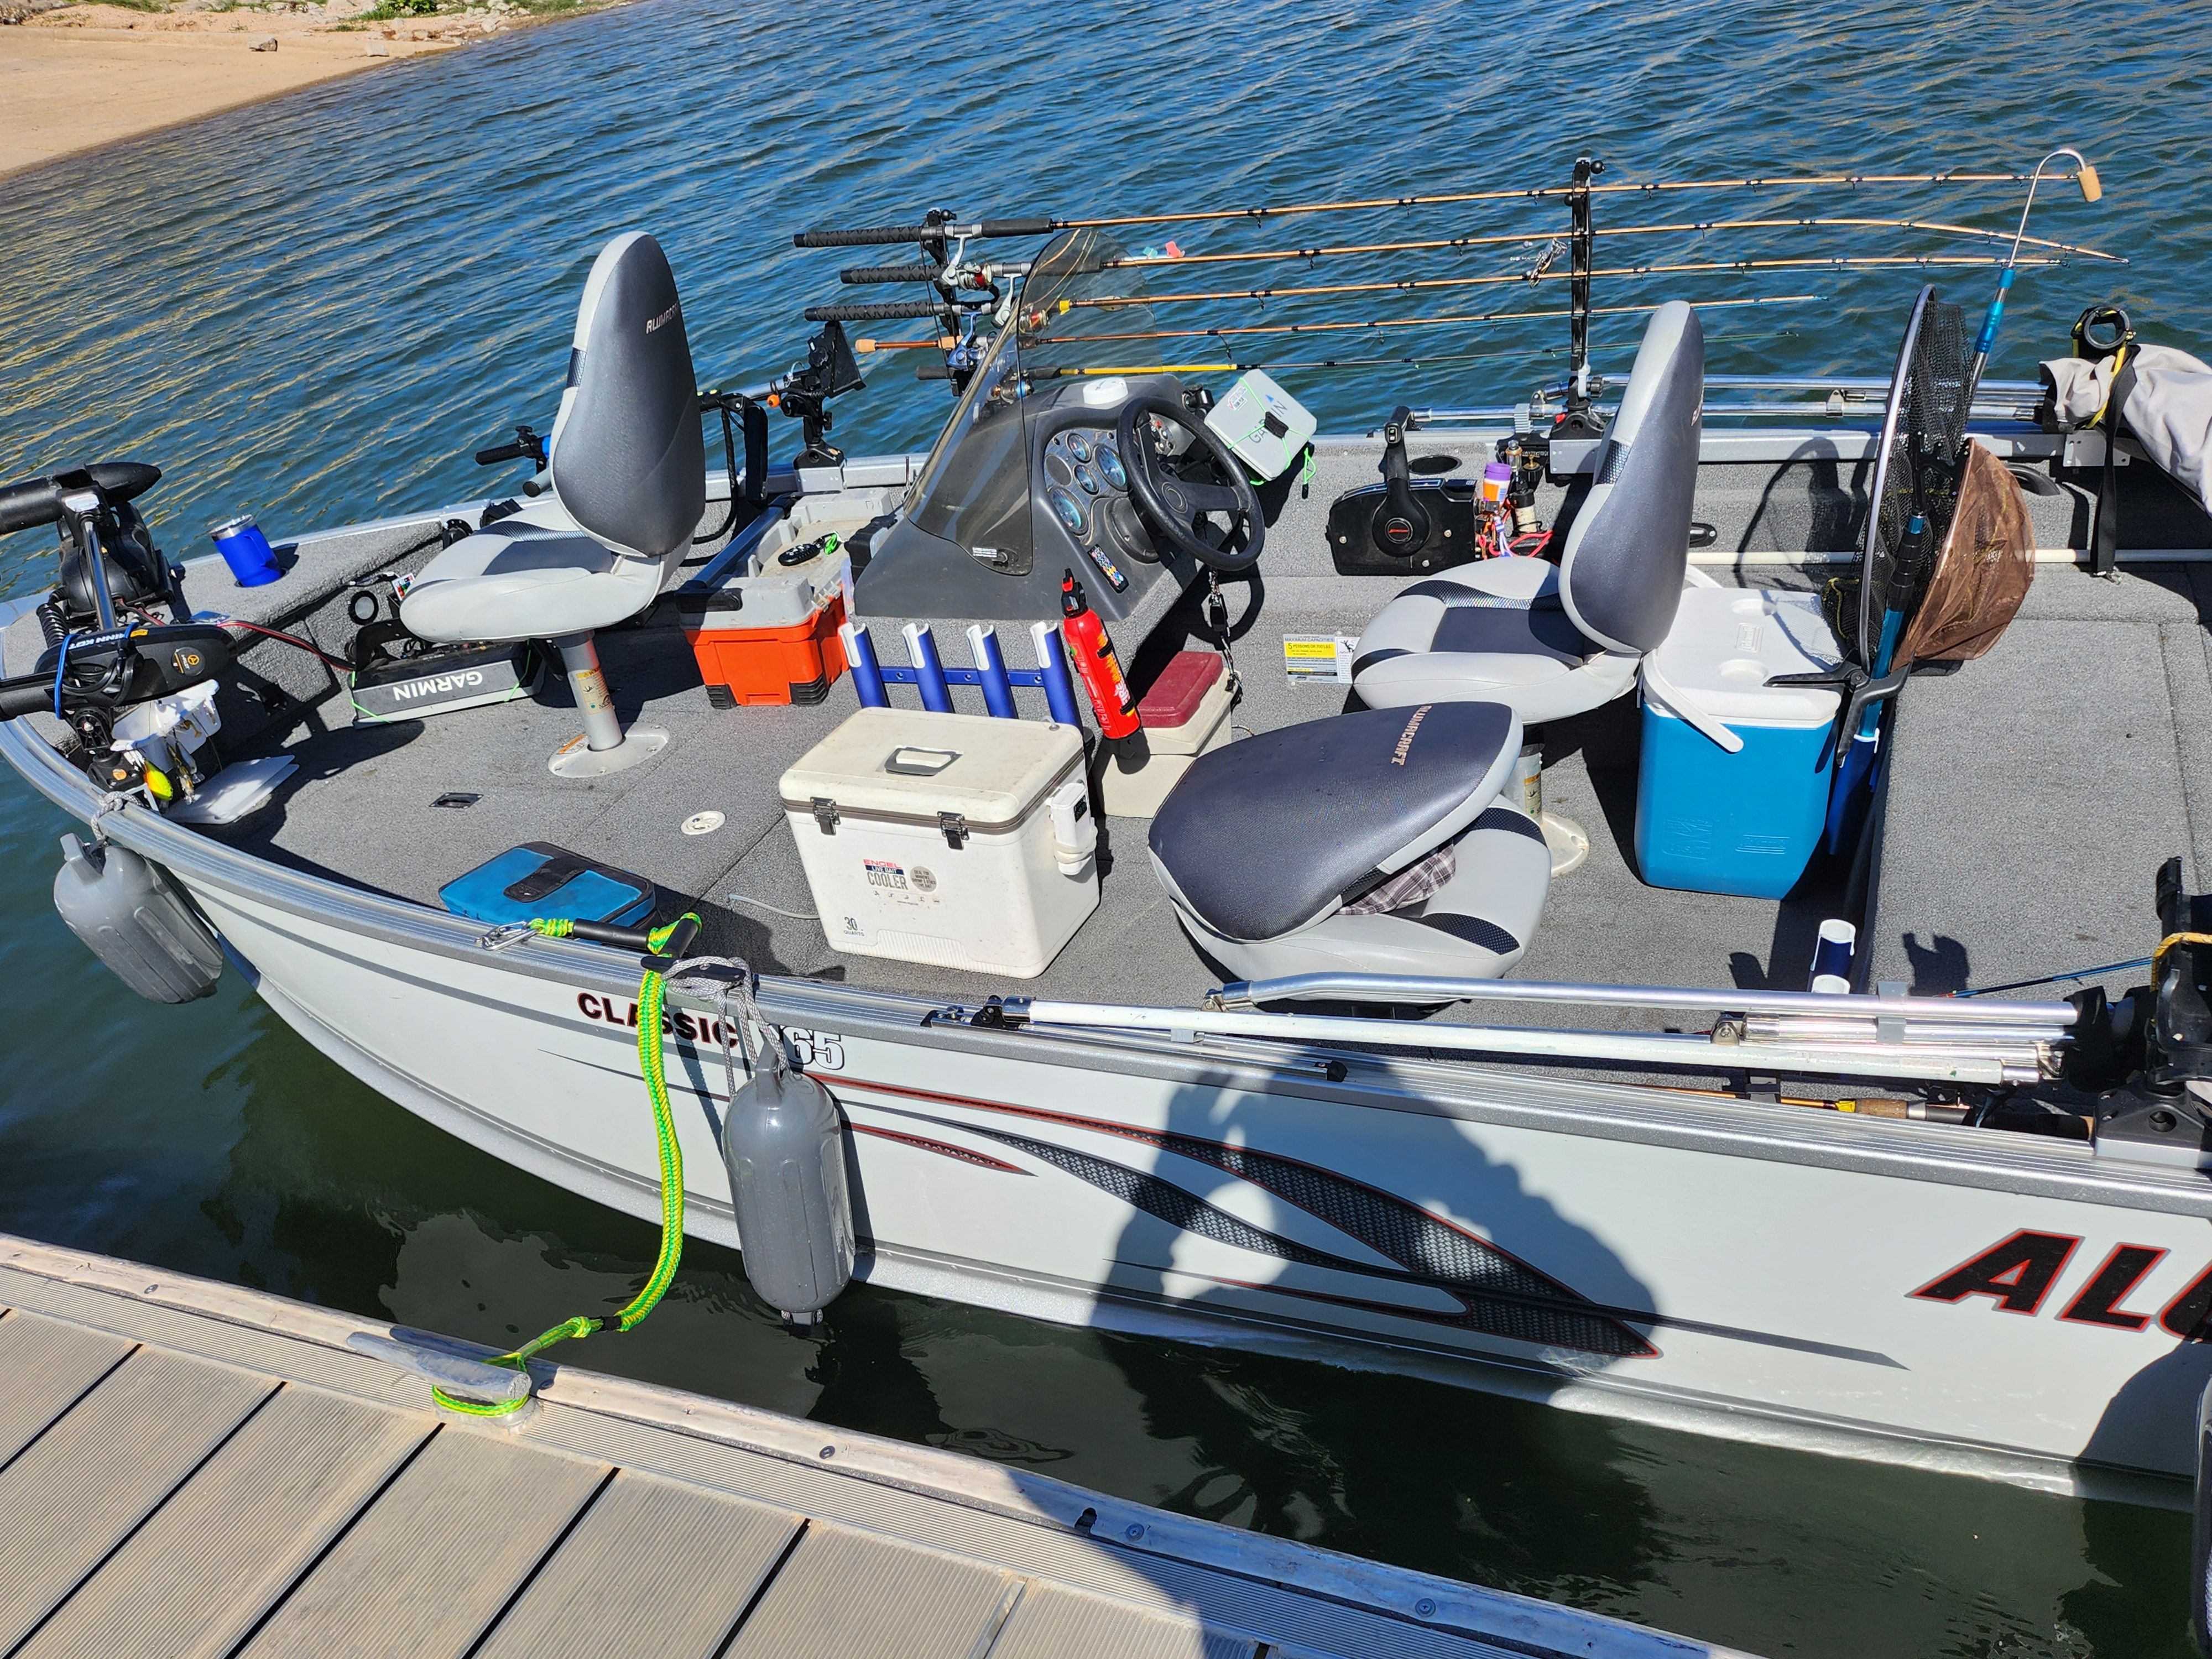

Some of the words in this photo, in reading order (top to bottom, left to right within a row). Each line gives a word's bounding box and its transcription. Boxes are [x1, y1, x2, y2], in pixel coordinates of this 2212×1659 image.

[68, 638, 95, 649] KOT
[392, 671, 483, 701] GARMIN
[863, 859, 901, 869] ENGEL
[867, 871, 909, 890] COOLER
[844, 917, 858, 931] 30
